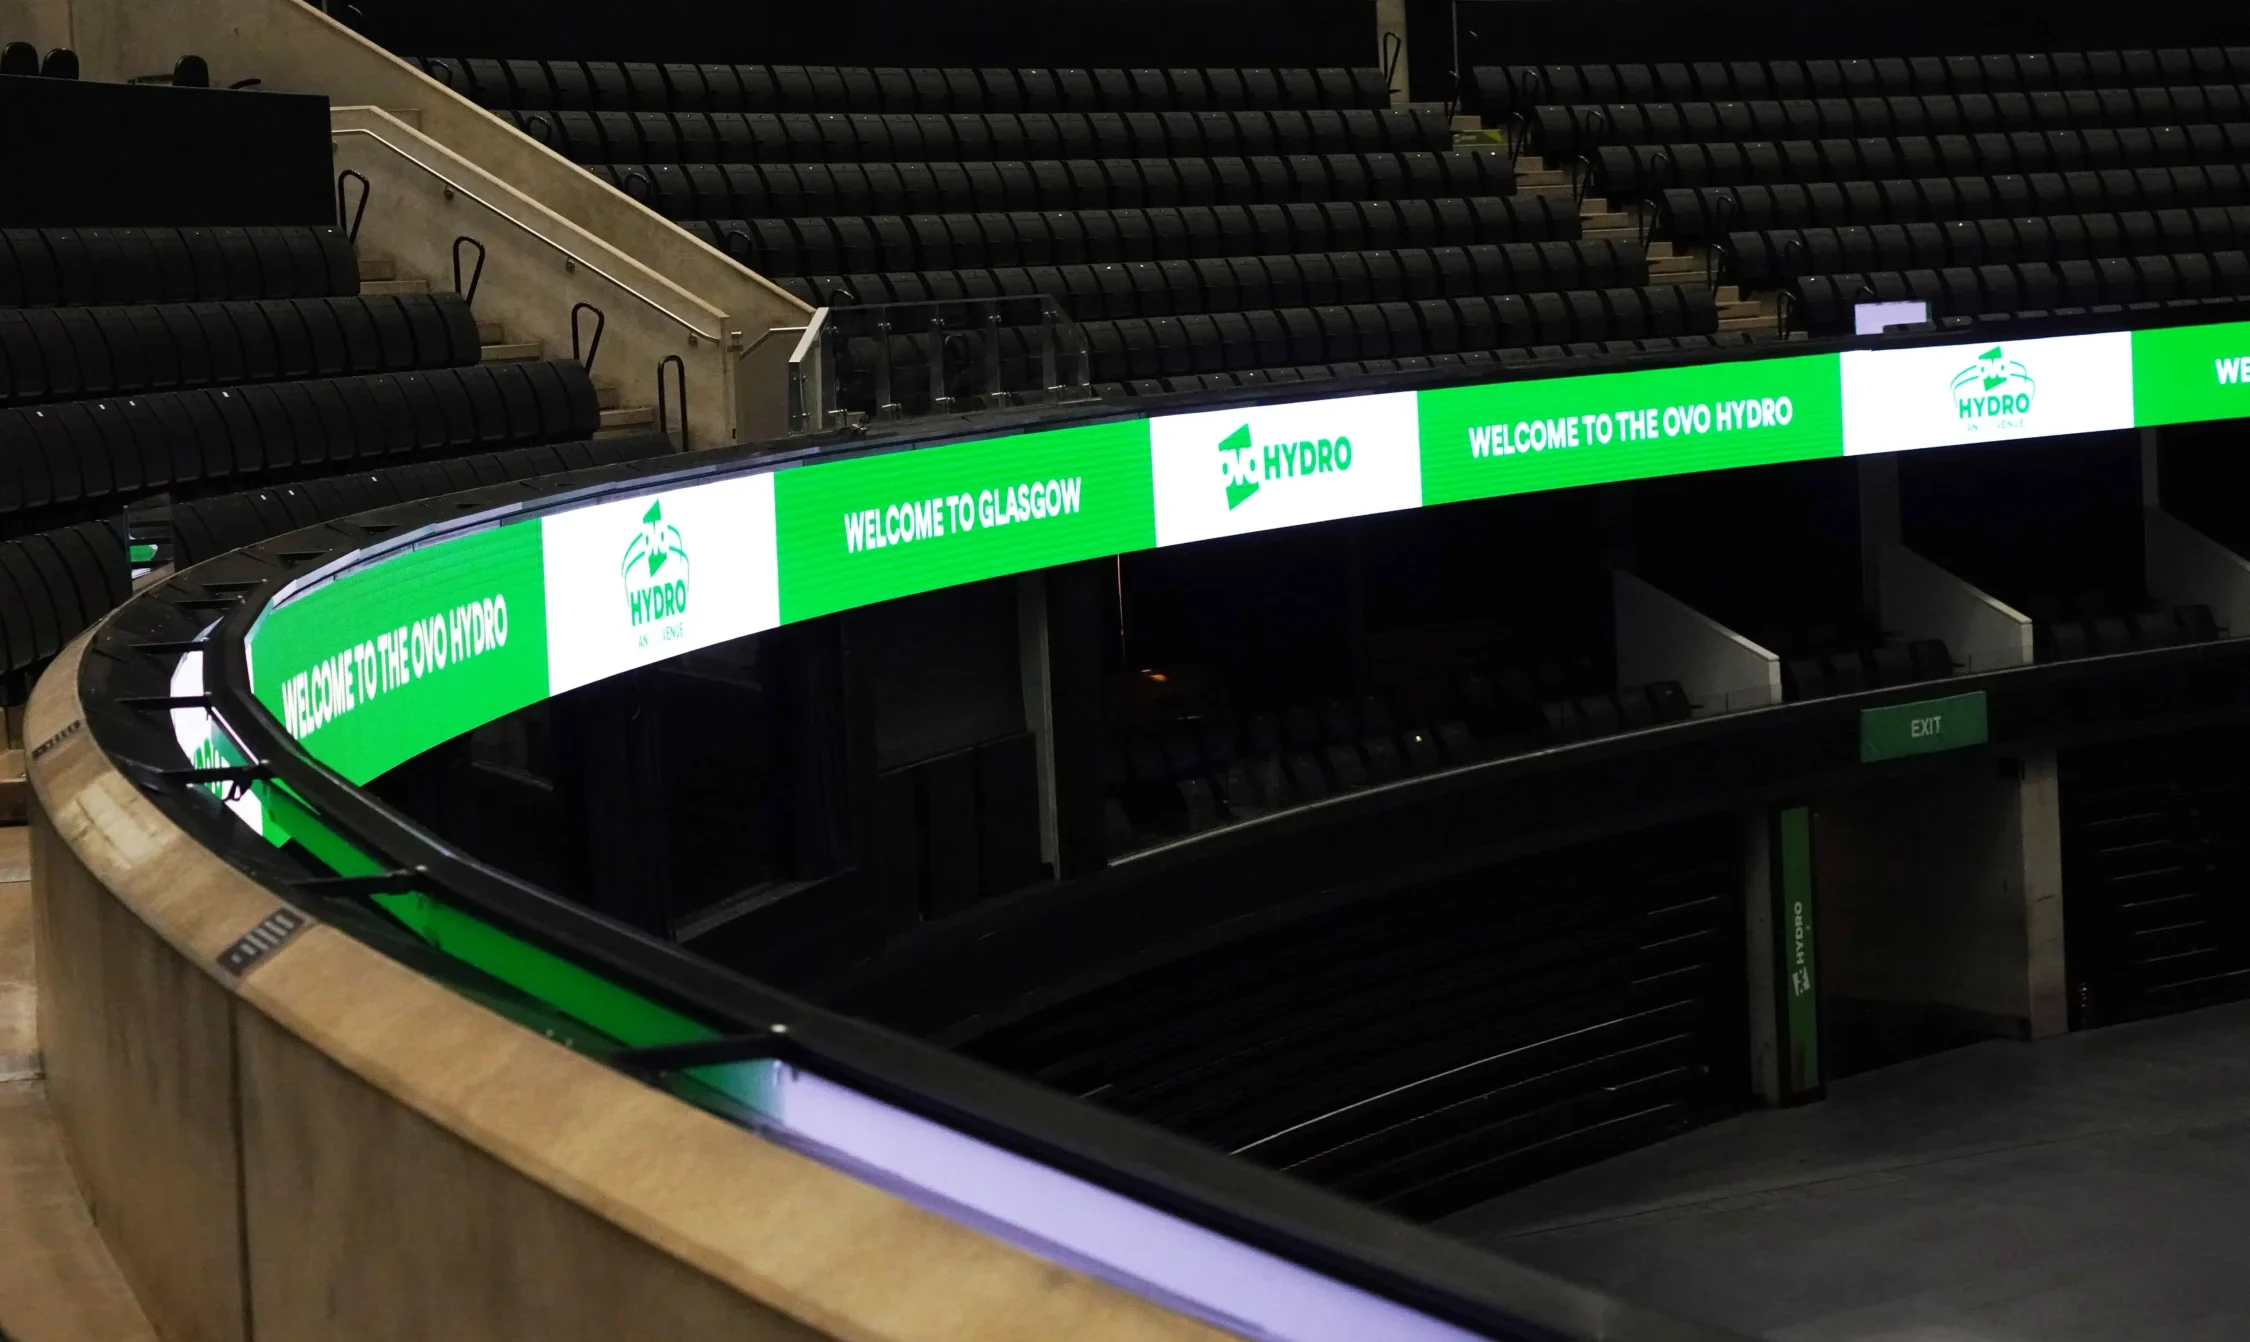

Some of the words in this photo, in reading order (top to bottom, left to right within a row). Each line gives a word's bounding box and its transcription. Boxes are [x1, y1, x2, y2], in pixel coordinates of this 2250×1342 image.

[2215, 357, 2250, 384] WE
[1468, 416, 1579, 458] WELCOME
[1581, 413, 1613, 446] TO
[1615, 408, 1659, 441] THE
[1662, 403, 1711, 437] OVO
[1715, 396, 1793, 431] HYDRO
[1959, 392, 2030, 419] HYDRO
[1263, 436, 1352, 480] HYDRO
[844, 497, 944, 553] WELCOME
[946, 492, 975, 534] TO
[978, 476, 1082, 529] GLASGOW
[630, 579, 686, 627] HYDRO
[281, 648, 355, 740] WELCOME
[354, 640, 378, 704] TO
[377, 626, 410, 693] THE
[411, 613, 448, 679] OVO
[449, 593, 508, 664] HYDRO
[1911, 716, 1942, 738] EXIT
[1794, 901, 1804, 964] HYDRO
